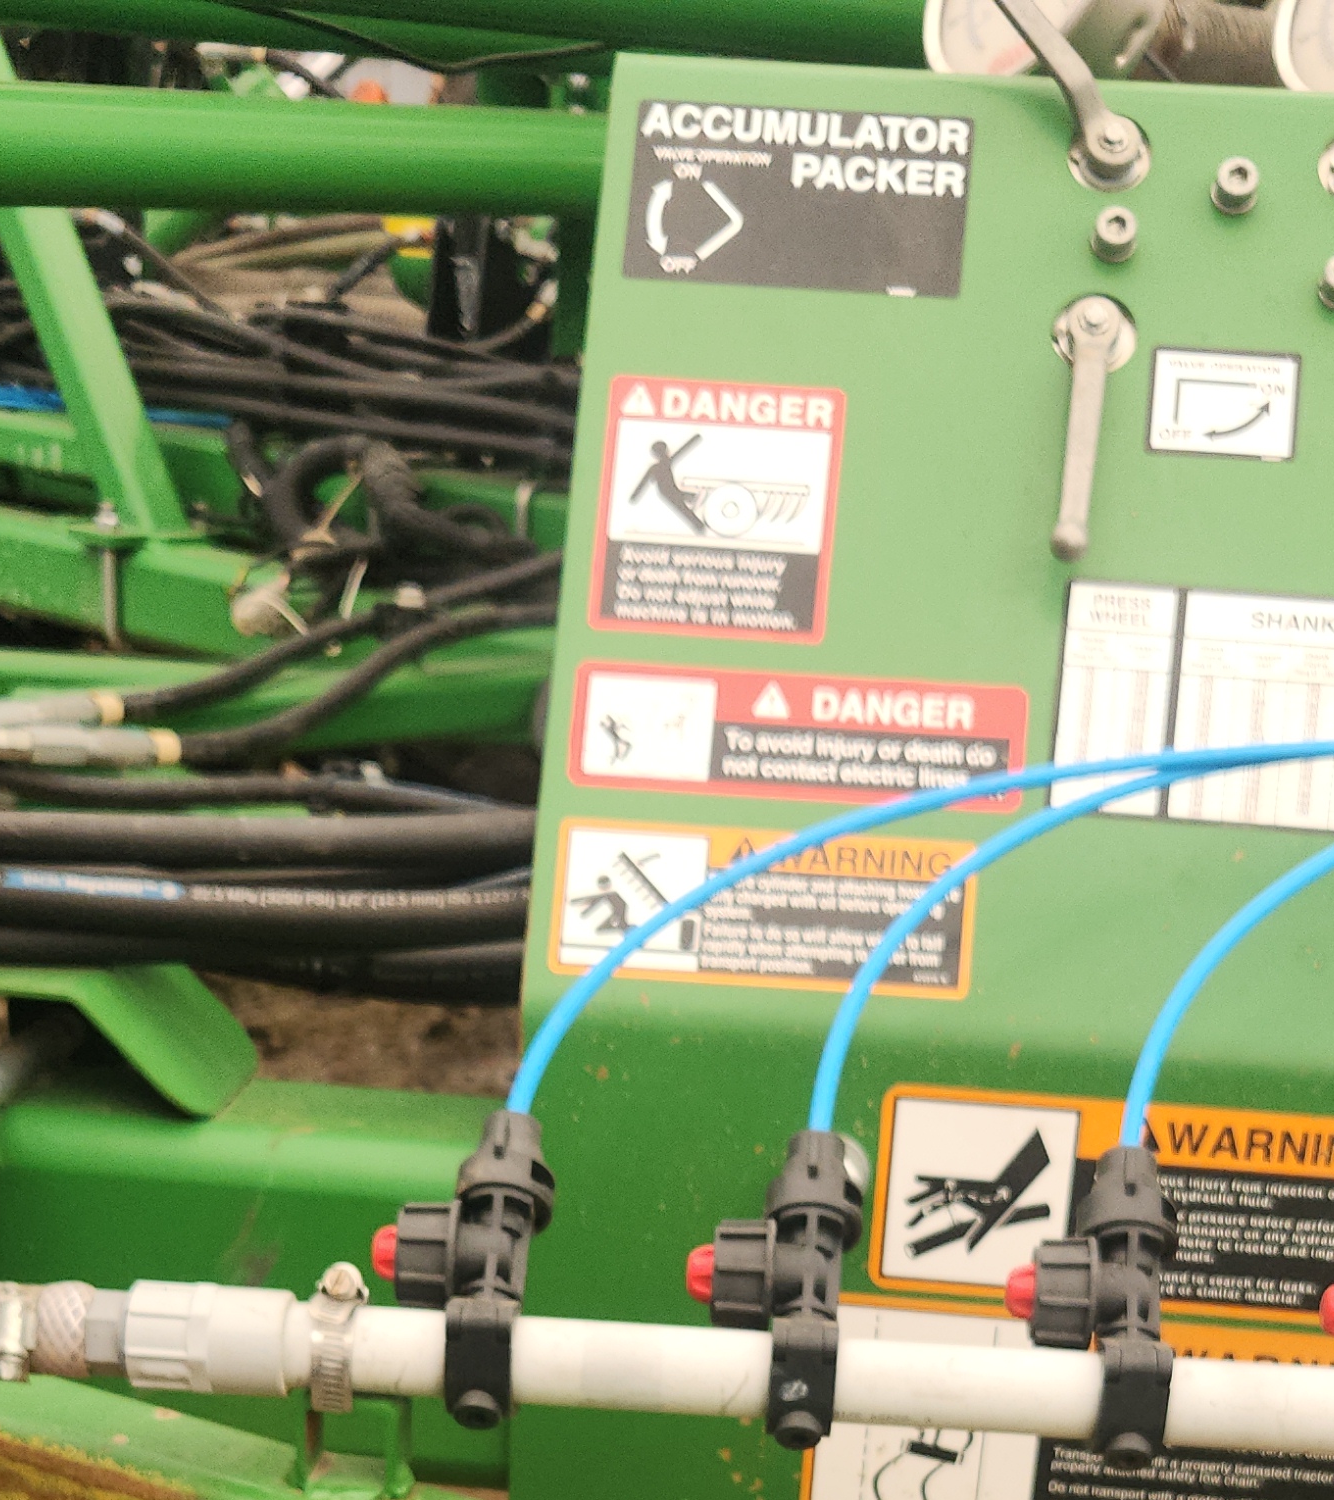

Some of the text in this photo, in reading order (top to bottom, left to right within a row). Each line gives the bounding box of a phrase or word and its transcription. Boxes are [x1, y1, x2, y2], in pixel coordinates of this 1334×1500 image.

[642, 103, 970, 154] ACCUMULATOR
[673, 162, 703, 180] ON
[791, 153, 966, 198] PACKER
[663, 386, 834, 429] DANGER
[811, 686, 975, 731] DANGER
[724, 726, 997, 767] To avoid injury or death do
[722, 754, 758, 777] not
[759, 756, 838, 782] contact
[839, 761, 917, 786] electric
[703, 921, 748, 939] Failure
[749, 924, 763, 940] to
[765, 925, 781, 941] do
[1173, 1190, 1234, 1206] hydraulic
[1189, 1175, 1226, 1192] injury
[1231, 1176, 1261, 1193] from
[1266, 1182, 1323, 1199] injection
[1188, 1211, 1246, 1228] pressure
[1250, 1214, 1293, 1230] before
[1178, 1236, 1214, 1250] Refer
[1217, 1239, 1231, 1251] to
[1234, 1241, 1280, 1255] tractor
[1283, 1243, 1309, 1257] and
[1243, 1229, 1259, 1240] on
[1264, 1230, 1289, 1244] any
[1178, 1287, 1192, 1297] or
[1196, 1285, 1242, 1300] similar
[1192, 1273, 1209, 1285] to
[1209, 1274, 1251, 1289] search
[1256, 1277, 1276, 1291] for
[1051, 1460, 1101, 1476] properly
[1158, 1470, 1197, 1484] safety
[1151, 1456, 1168, 1468] ith
[1170, 1458, 1180, 1469] a
[1181, 1460, 1232, 1475] properly
[1235, 1464, 1292, 1479] ballasted
[1294, 1468, 1334, 1483] tractor
[1048, 1479, 1066, 1494] Do
[1068, 1483, 1089, 1494] not
[1091, 1485, 1146, 1500] transport
